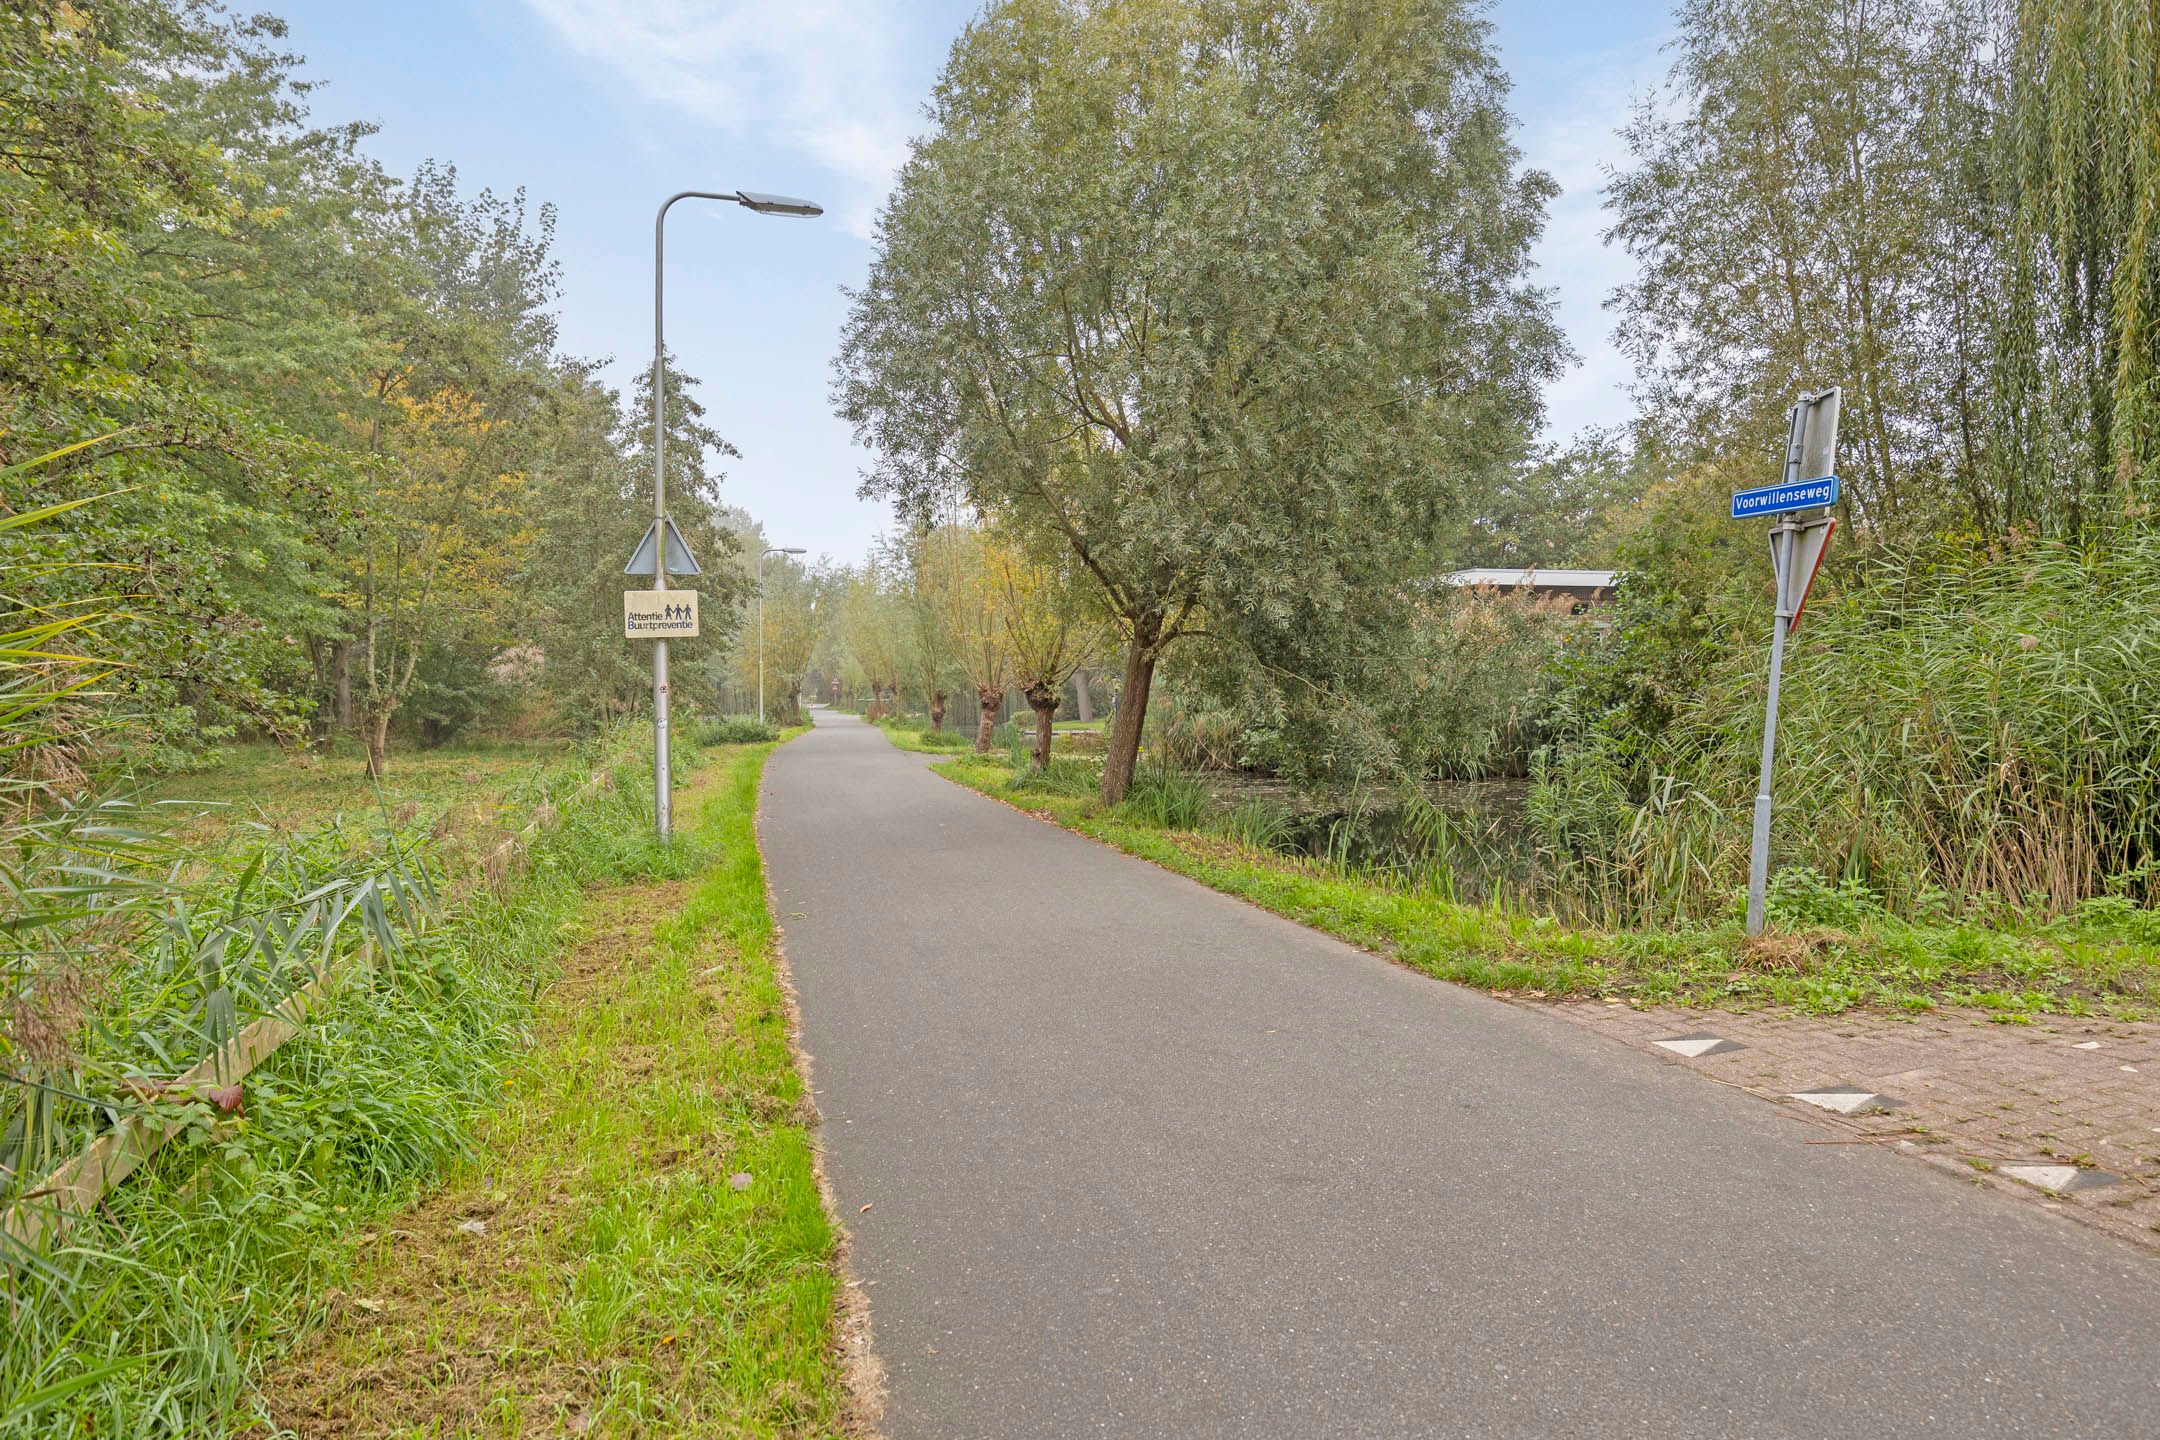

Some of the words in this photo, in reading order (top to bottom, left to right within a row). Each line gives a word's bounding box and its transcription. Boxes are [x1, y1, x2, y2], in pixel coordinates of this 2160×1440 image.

[1736, 485, 1830, 510] Voorwillenseweg
[628, 611, 663, 621] Attentie
[628, 620, 693, 631] Buurtpreventie
